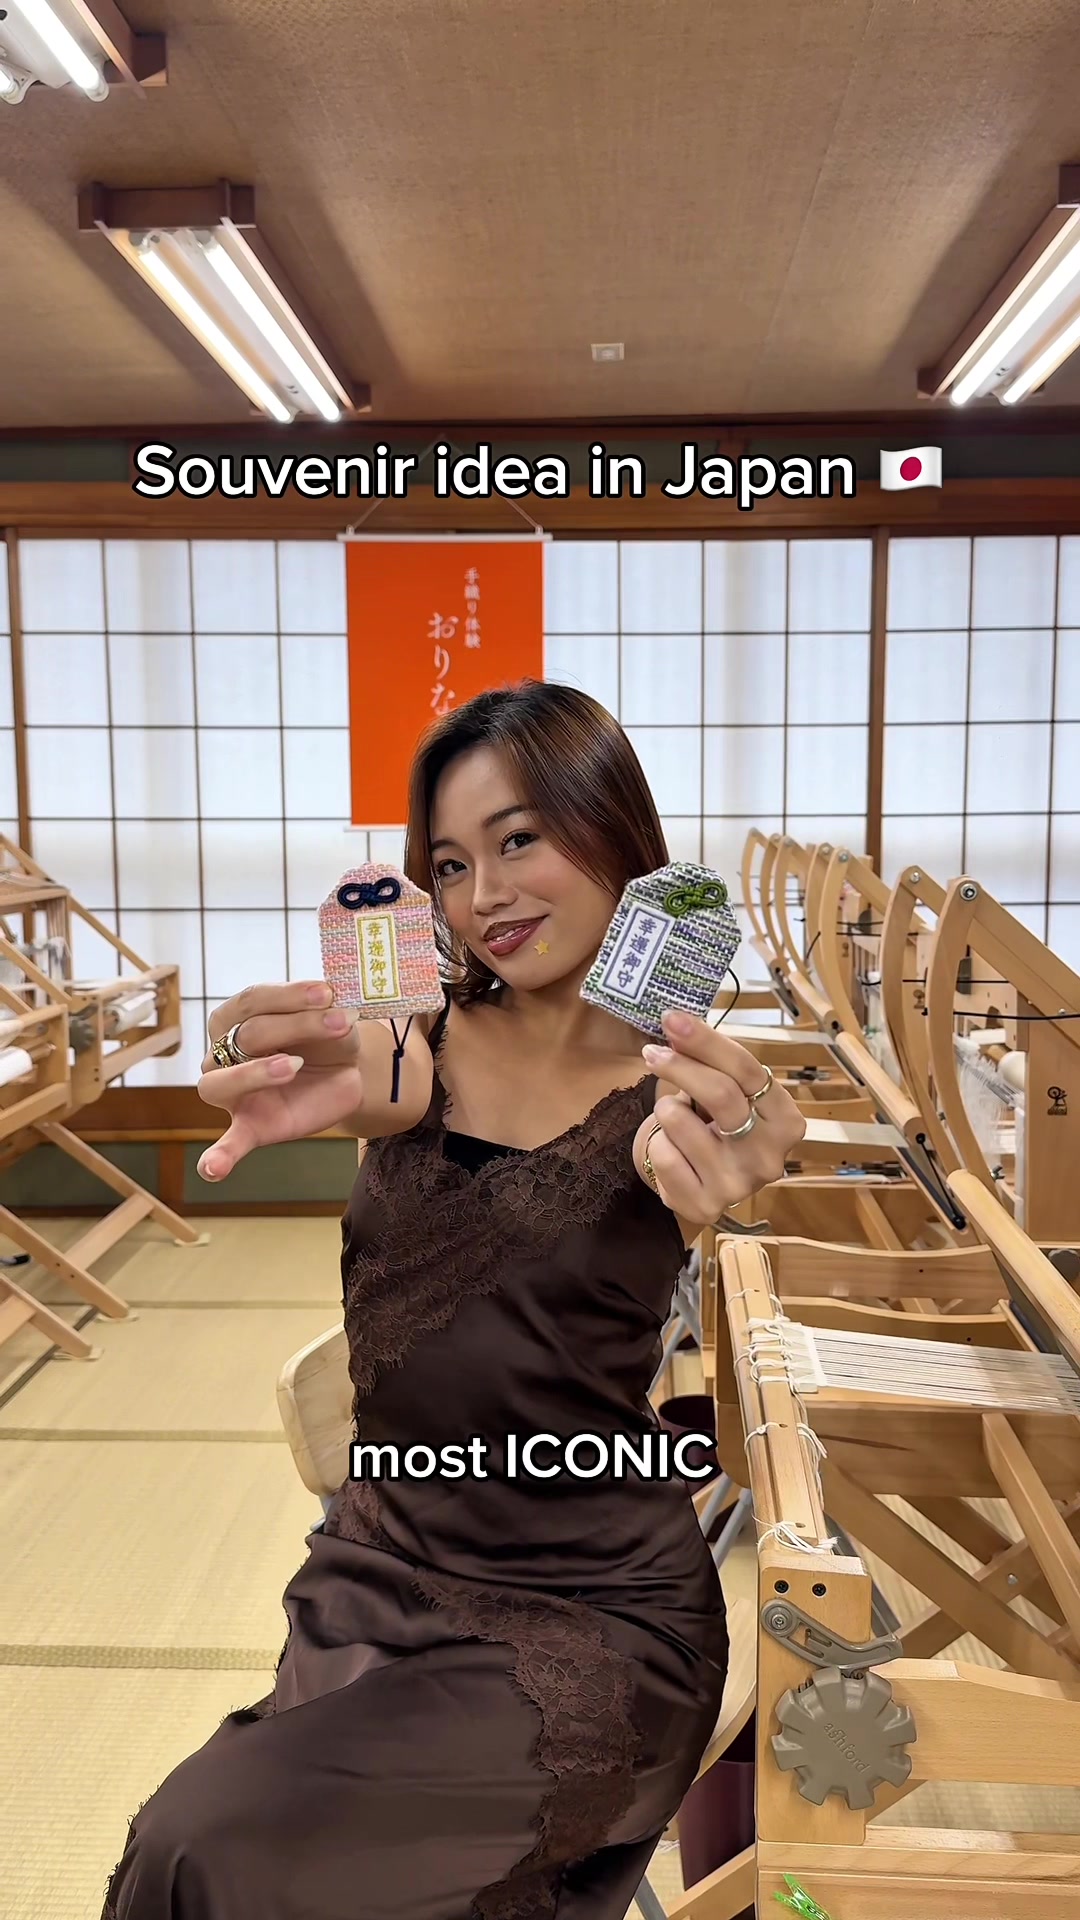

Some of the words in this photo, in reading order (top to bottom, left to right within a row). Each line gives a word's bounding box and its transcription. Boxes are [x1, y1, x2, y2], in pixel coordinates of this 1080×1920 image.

[463, 566, 482, 649] 手織り体験
[367, 923, 388, 993] 幸運御守
[616, 917, 658, 989] 幸運御守
[823, 1722, 871, 1773] ashford
